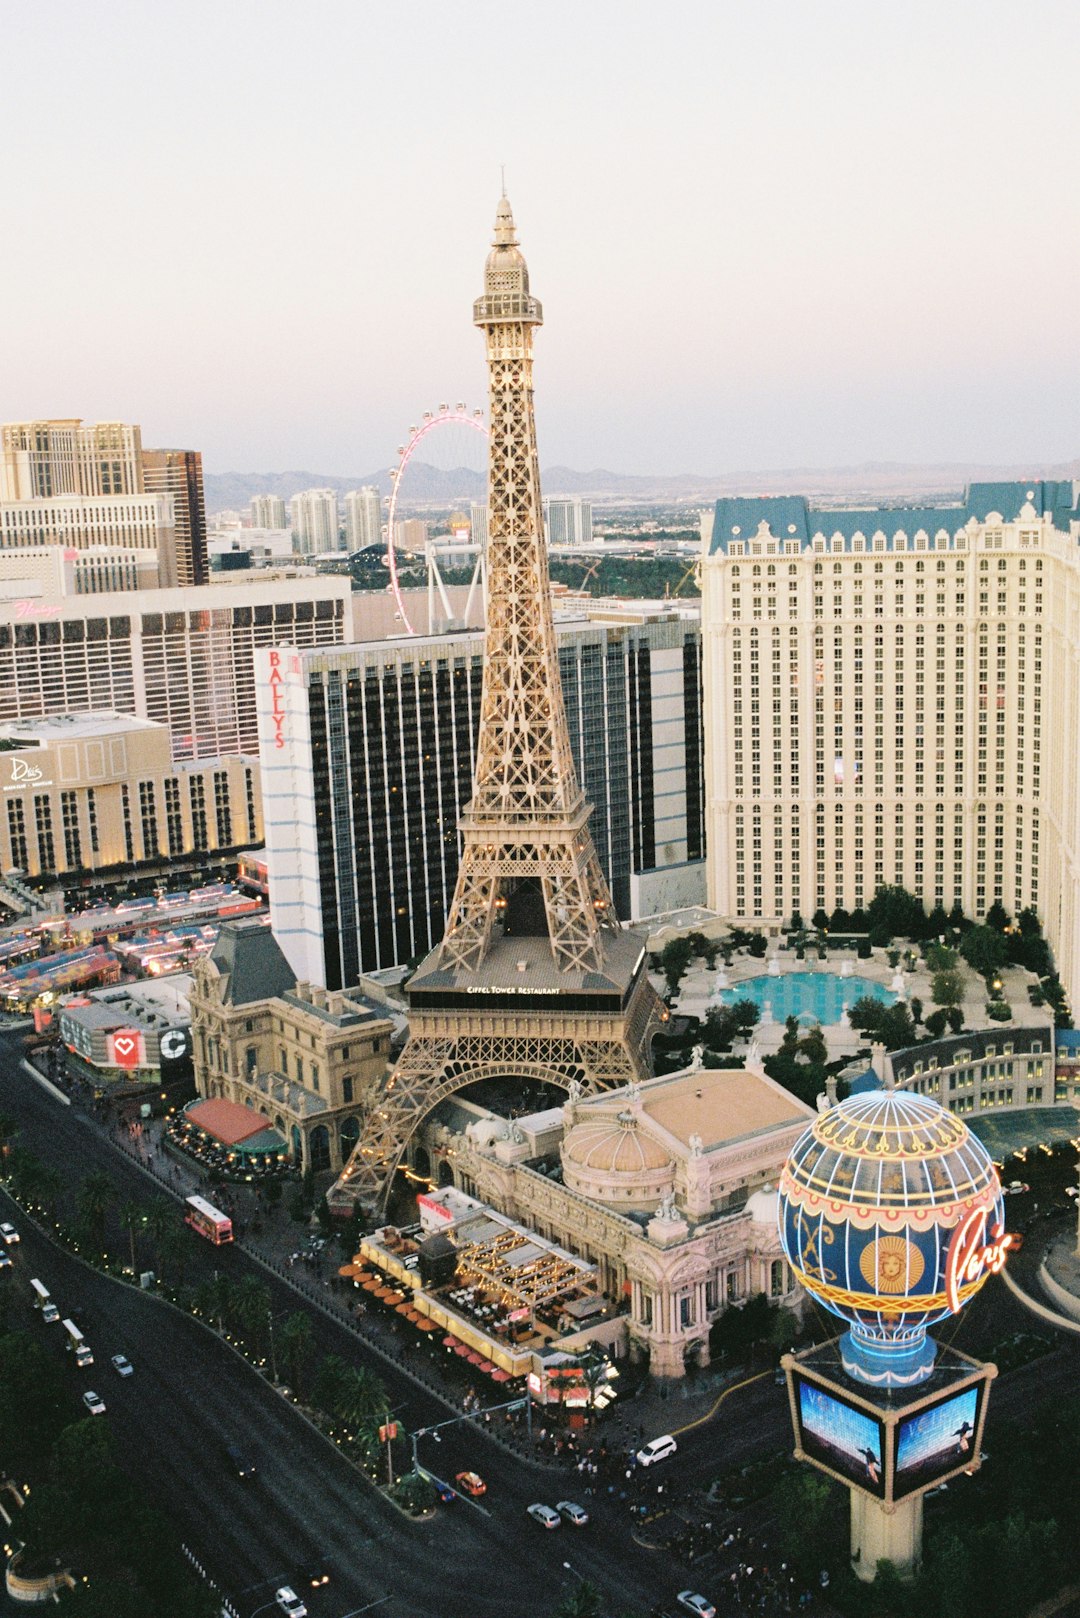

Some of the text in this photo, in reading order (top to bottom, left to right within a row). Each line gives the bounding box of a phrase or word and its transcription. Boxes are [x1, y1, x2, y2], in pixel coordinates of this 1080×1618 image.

[269, 651, 286, 749] BALLYS
[466, 985, 560, 995] EIFFEL TOWER RESTAURANT
[946, 1206, 1016, 1314] Paris
